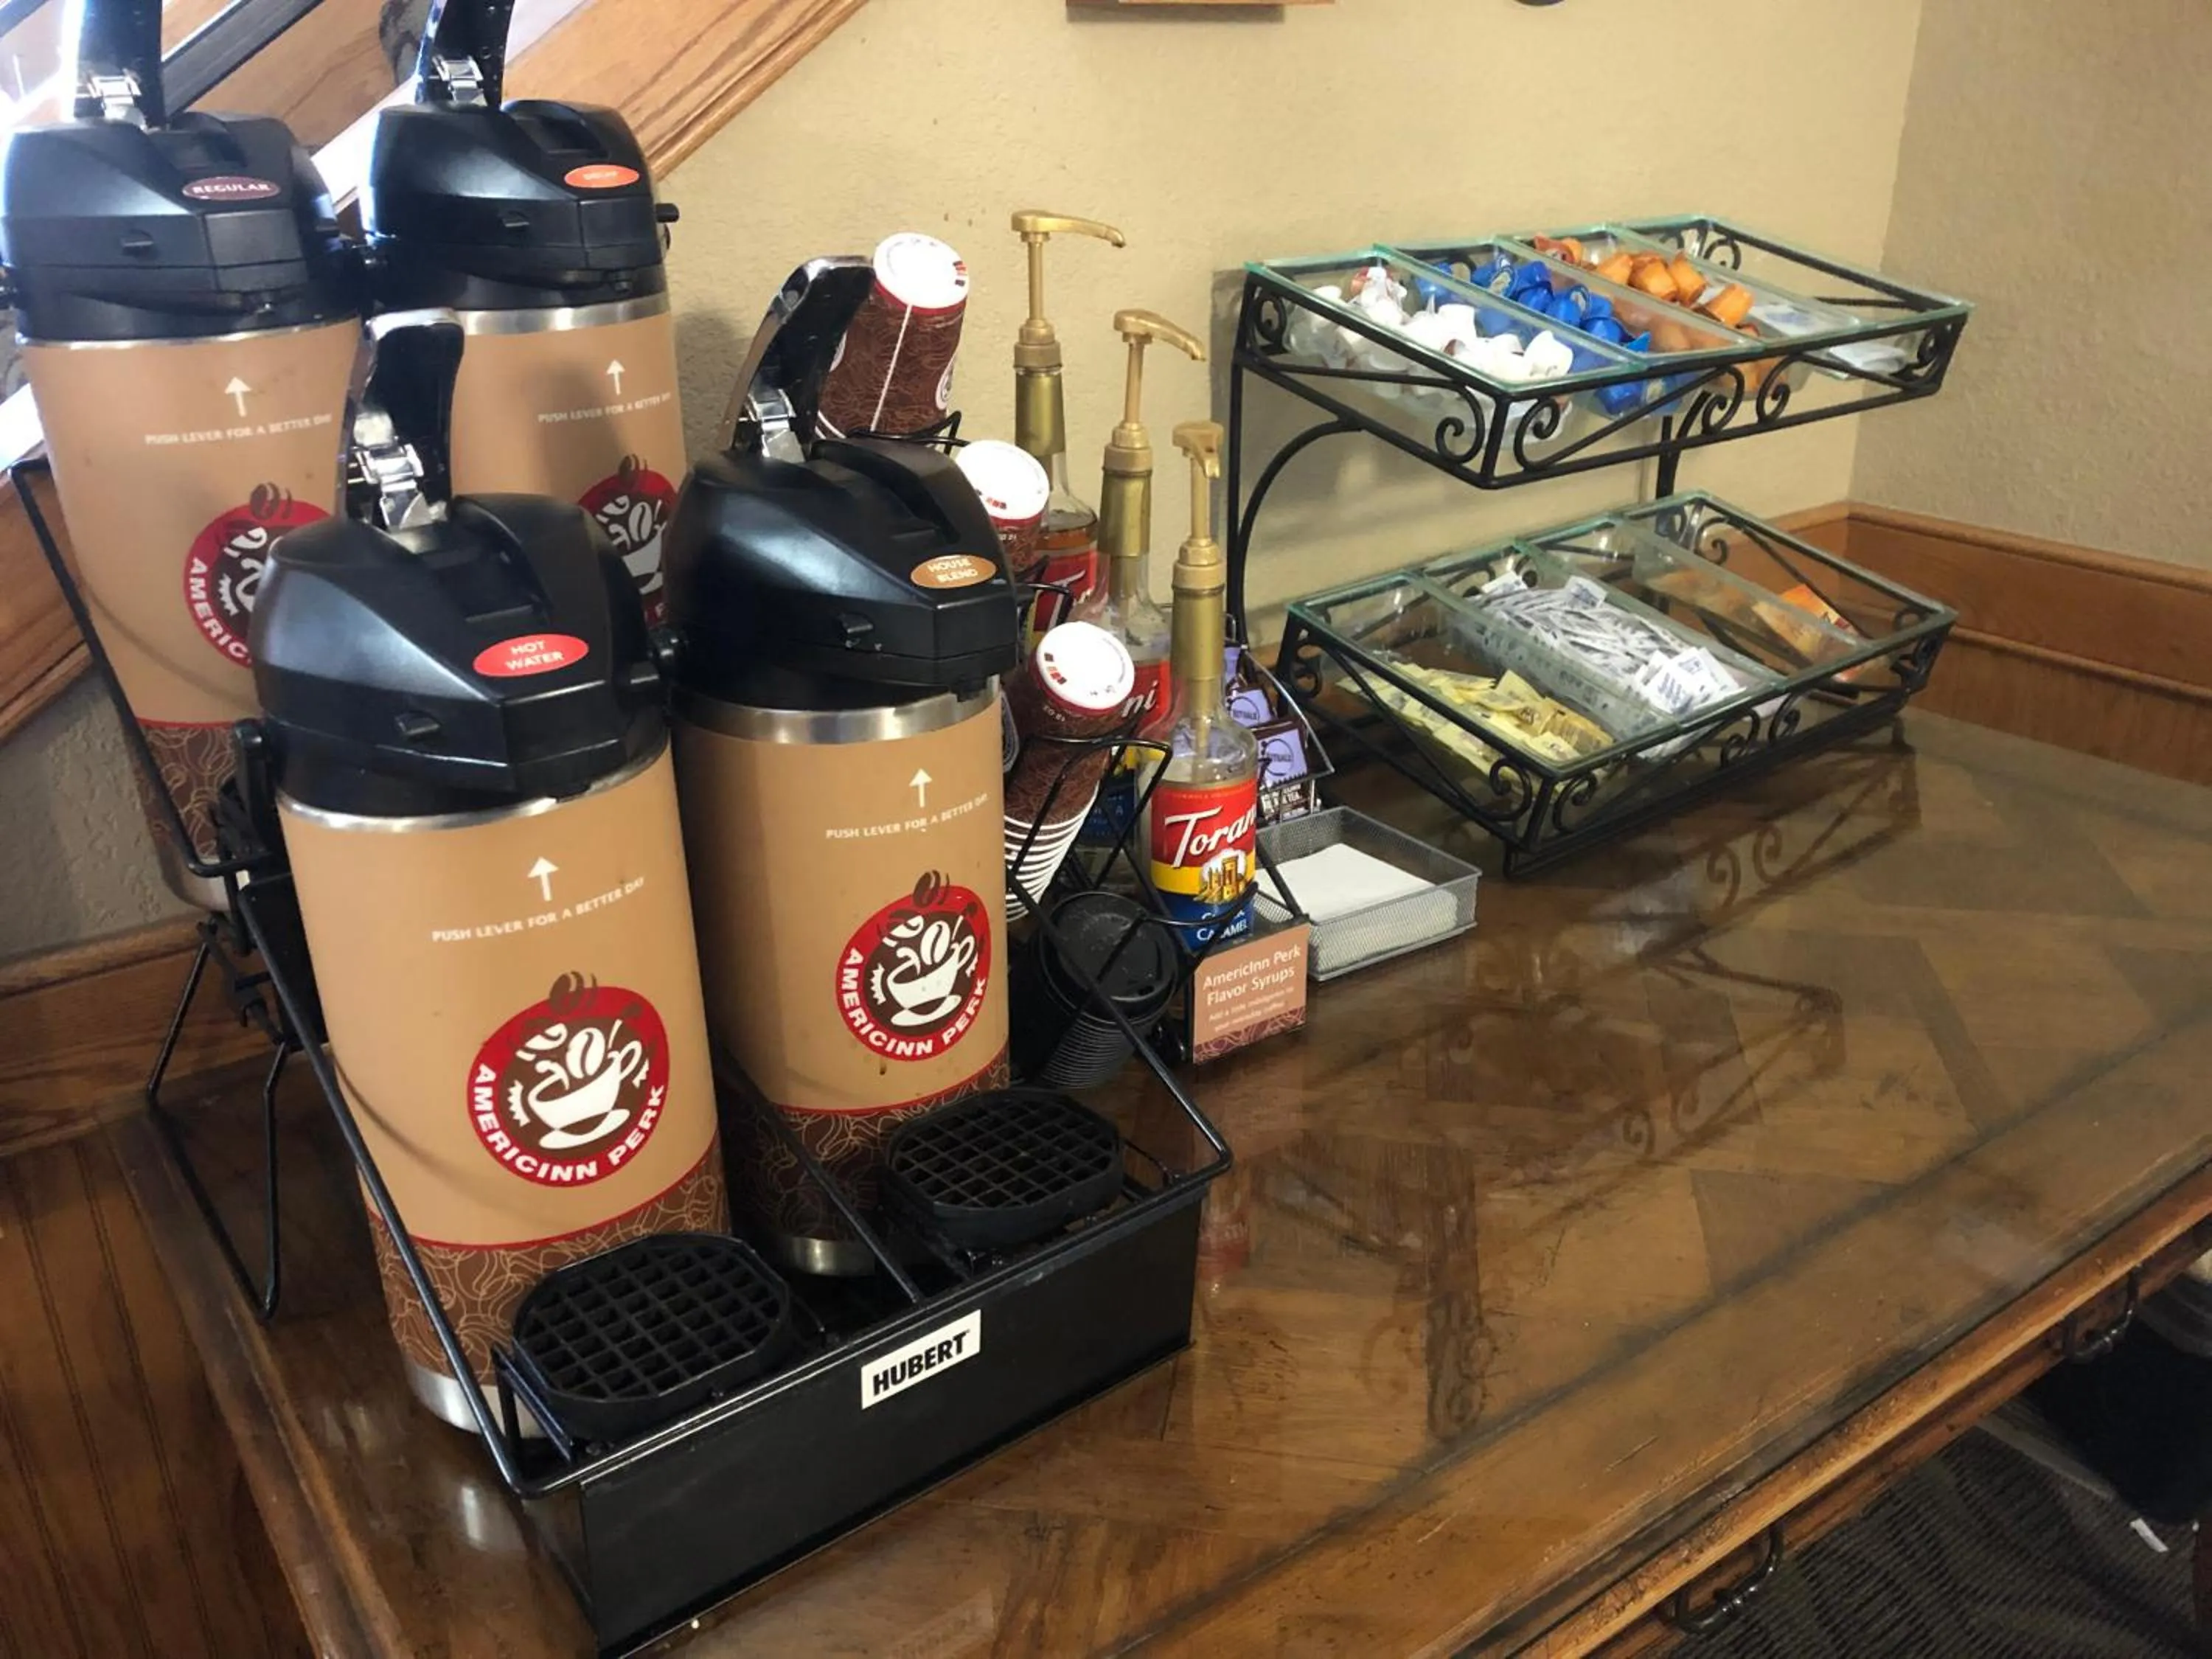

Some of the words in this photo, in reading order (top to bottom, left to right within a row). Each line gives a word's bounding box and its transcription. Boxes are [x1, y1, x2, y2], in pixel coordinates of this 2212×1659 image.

[192, 183, 271, 195] REGULAR
[182, 430, 222, 442] LEVER
[226, 427, 253, 439] FOR
[256, 425, 265, 434] A
[268, 418, 310, 434] BETTER
[927, 558, 972, 572] HOUSE
[937, 568, 978, 582] BLEND
[189, 557, 251, 663] AMERIC
[504, 651, 564, 670] WATER
[510, 640, 546, 655] HOT
[826, 829, 859, 838] PUSH
[863, 823, 900, 836] LEVER
[905, 818, 927, 830] FOR
[931, 815, 939, 823] A
[942, 801, 973, 821] BETTER
[1165, 804, 1256, 868] Toran
[431, 928, 471, 942] PUSH
[476, 921, 523, 937] LEVER
[527, 913, 557, 928] FOR
[562, 908, 572, 919] A
[576, 889, 622, 914] BETTER
[625, 876, 644, 894] DAY
[1197, 919, 1248, 940] CAAMEL
[1203, 958, 1270, 990] AmericInn
[1273, 945, 1301, 964] Perk
[1207, 983, 1247, 1006] Flavor
[1251, 966, 1295, 990] Syrups
[841, 947, 933, 1055] AMERICINN
[942, 978, 986, 1043] PERK
[474, 1063, 598, 1180] AMERICINN
[608, 1085, 664, 1165] PERK
[873, 1330, 967, 1396] HUBERT
